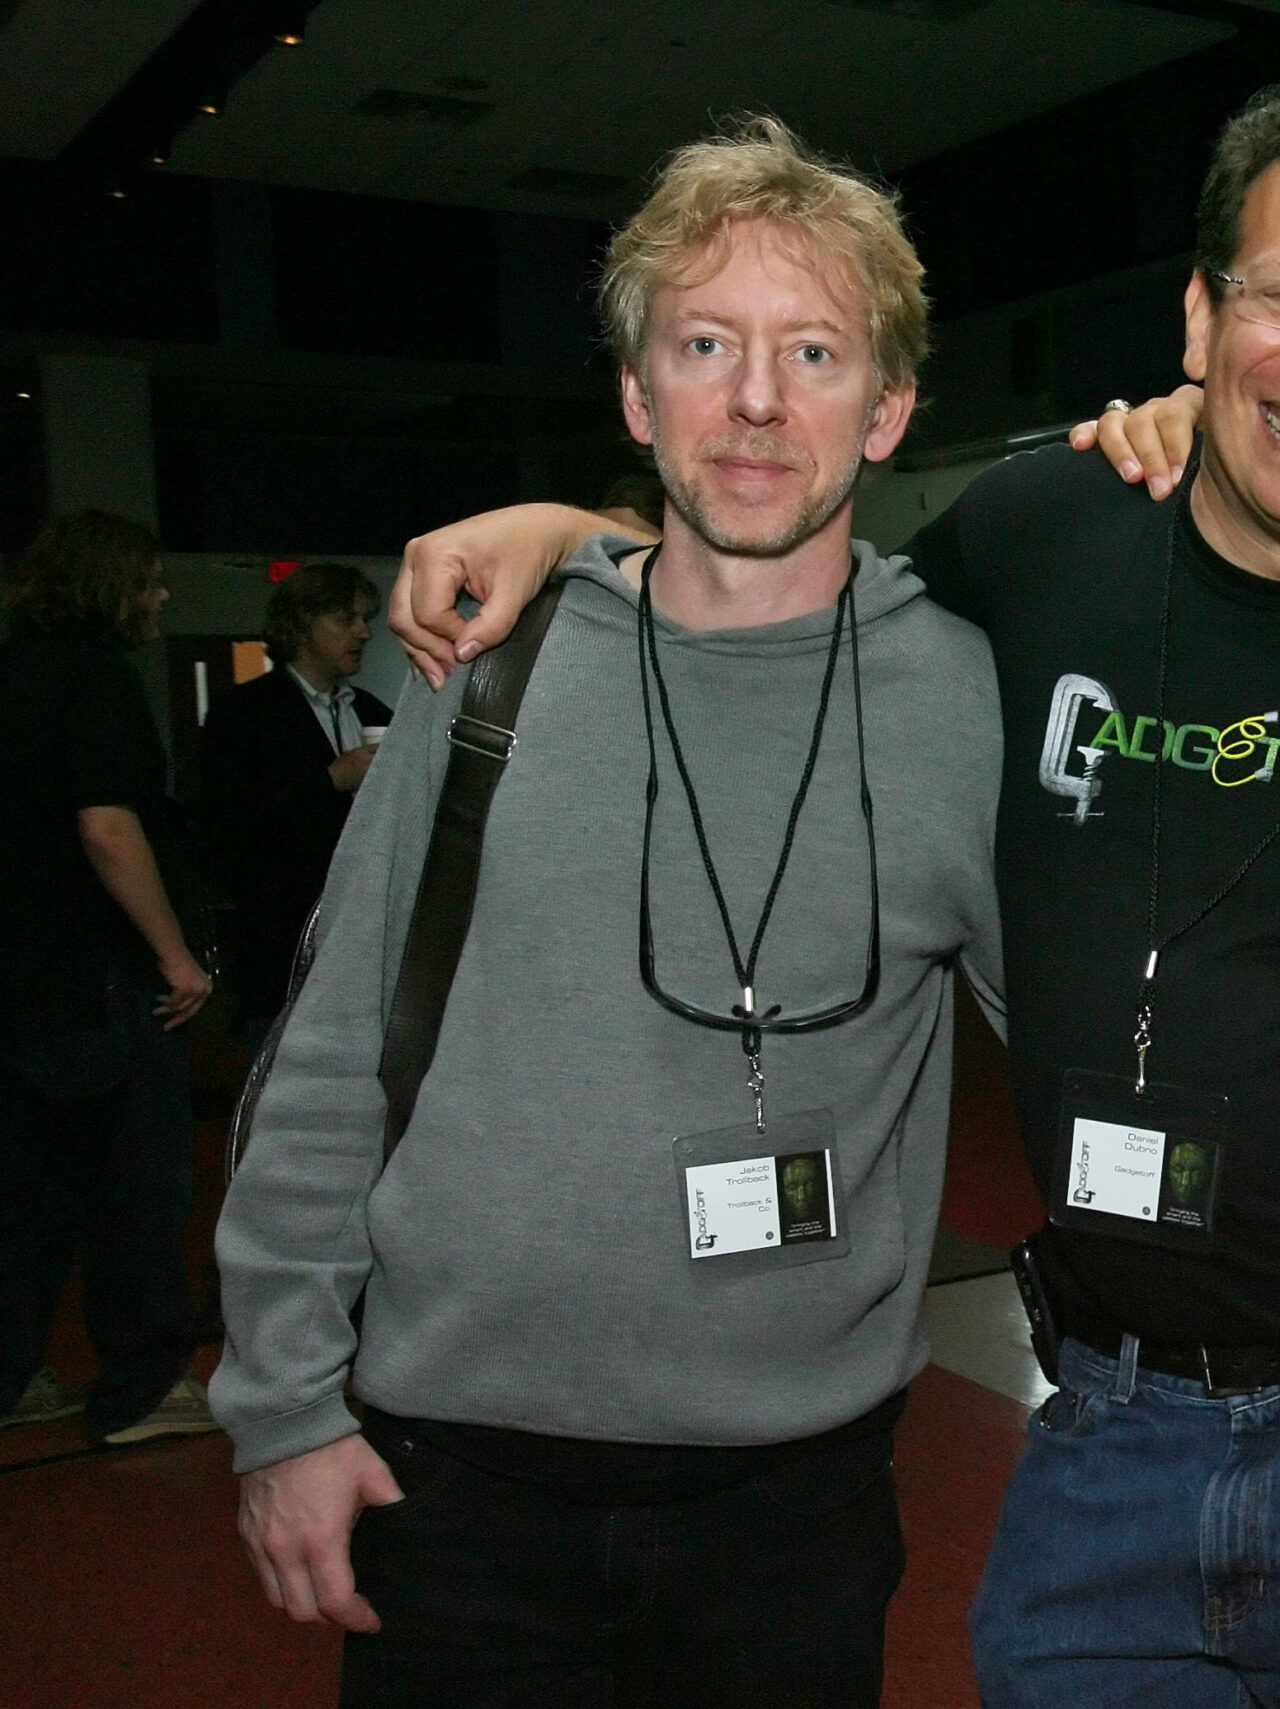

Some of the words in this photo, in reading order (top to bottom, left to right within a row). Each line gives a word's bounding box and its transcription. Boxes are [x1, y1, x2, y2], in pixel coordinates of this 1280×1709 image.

[1127, 1132, 1159, 1145] Daniel
[1124, 1142, 1158, 1155] Dubno
[739, 1165, 770, 1175] Jakob
[1114, 1165, 1155, 1179] Gadgetoff
